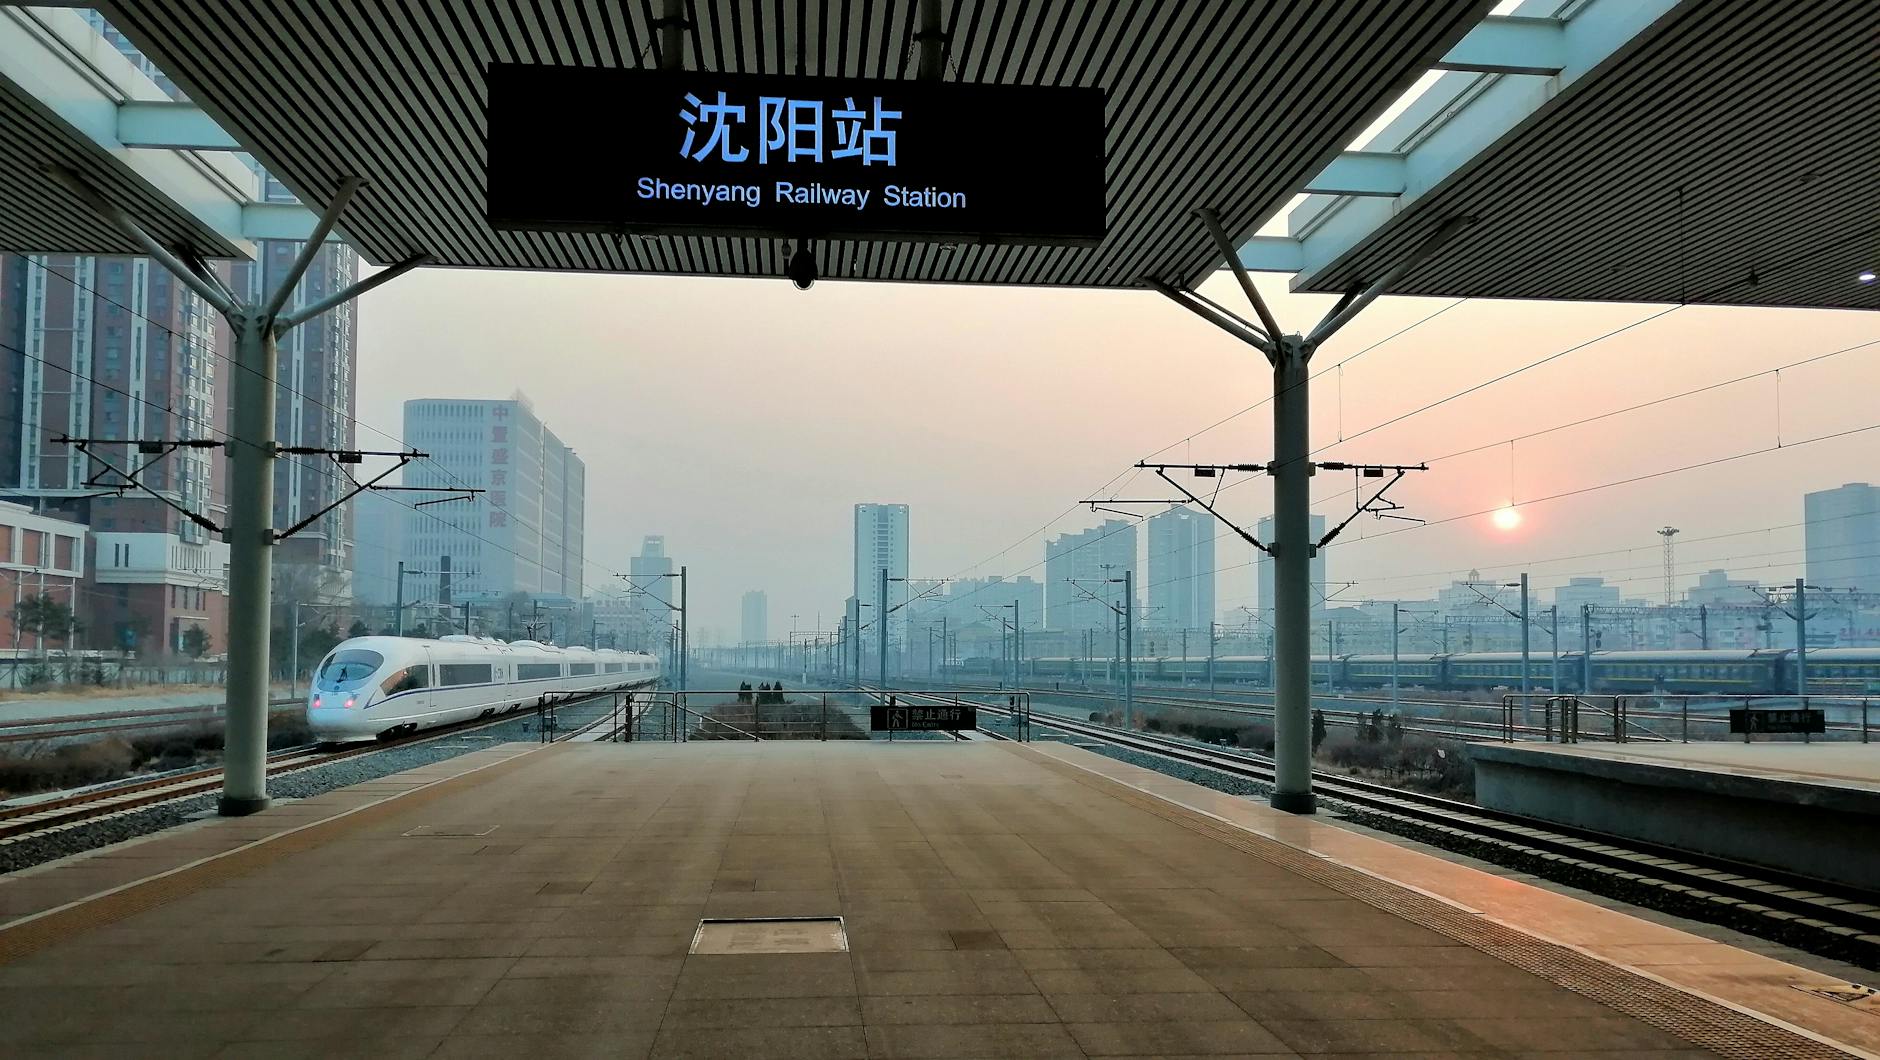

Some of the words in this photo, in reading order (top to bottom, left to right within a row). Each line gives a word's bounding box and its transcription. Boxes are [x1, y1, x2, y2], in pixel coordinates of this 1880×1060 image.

[679, 90, 903, 167] 沈阳站
[637, 177, 761, 208] Shenyang
[775, 181, 871, 211] Railway
[883, 184, 967, 209] Station
[911, 708, 961, 721] 禁止通行
